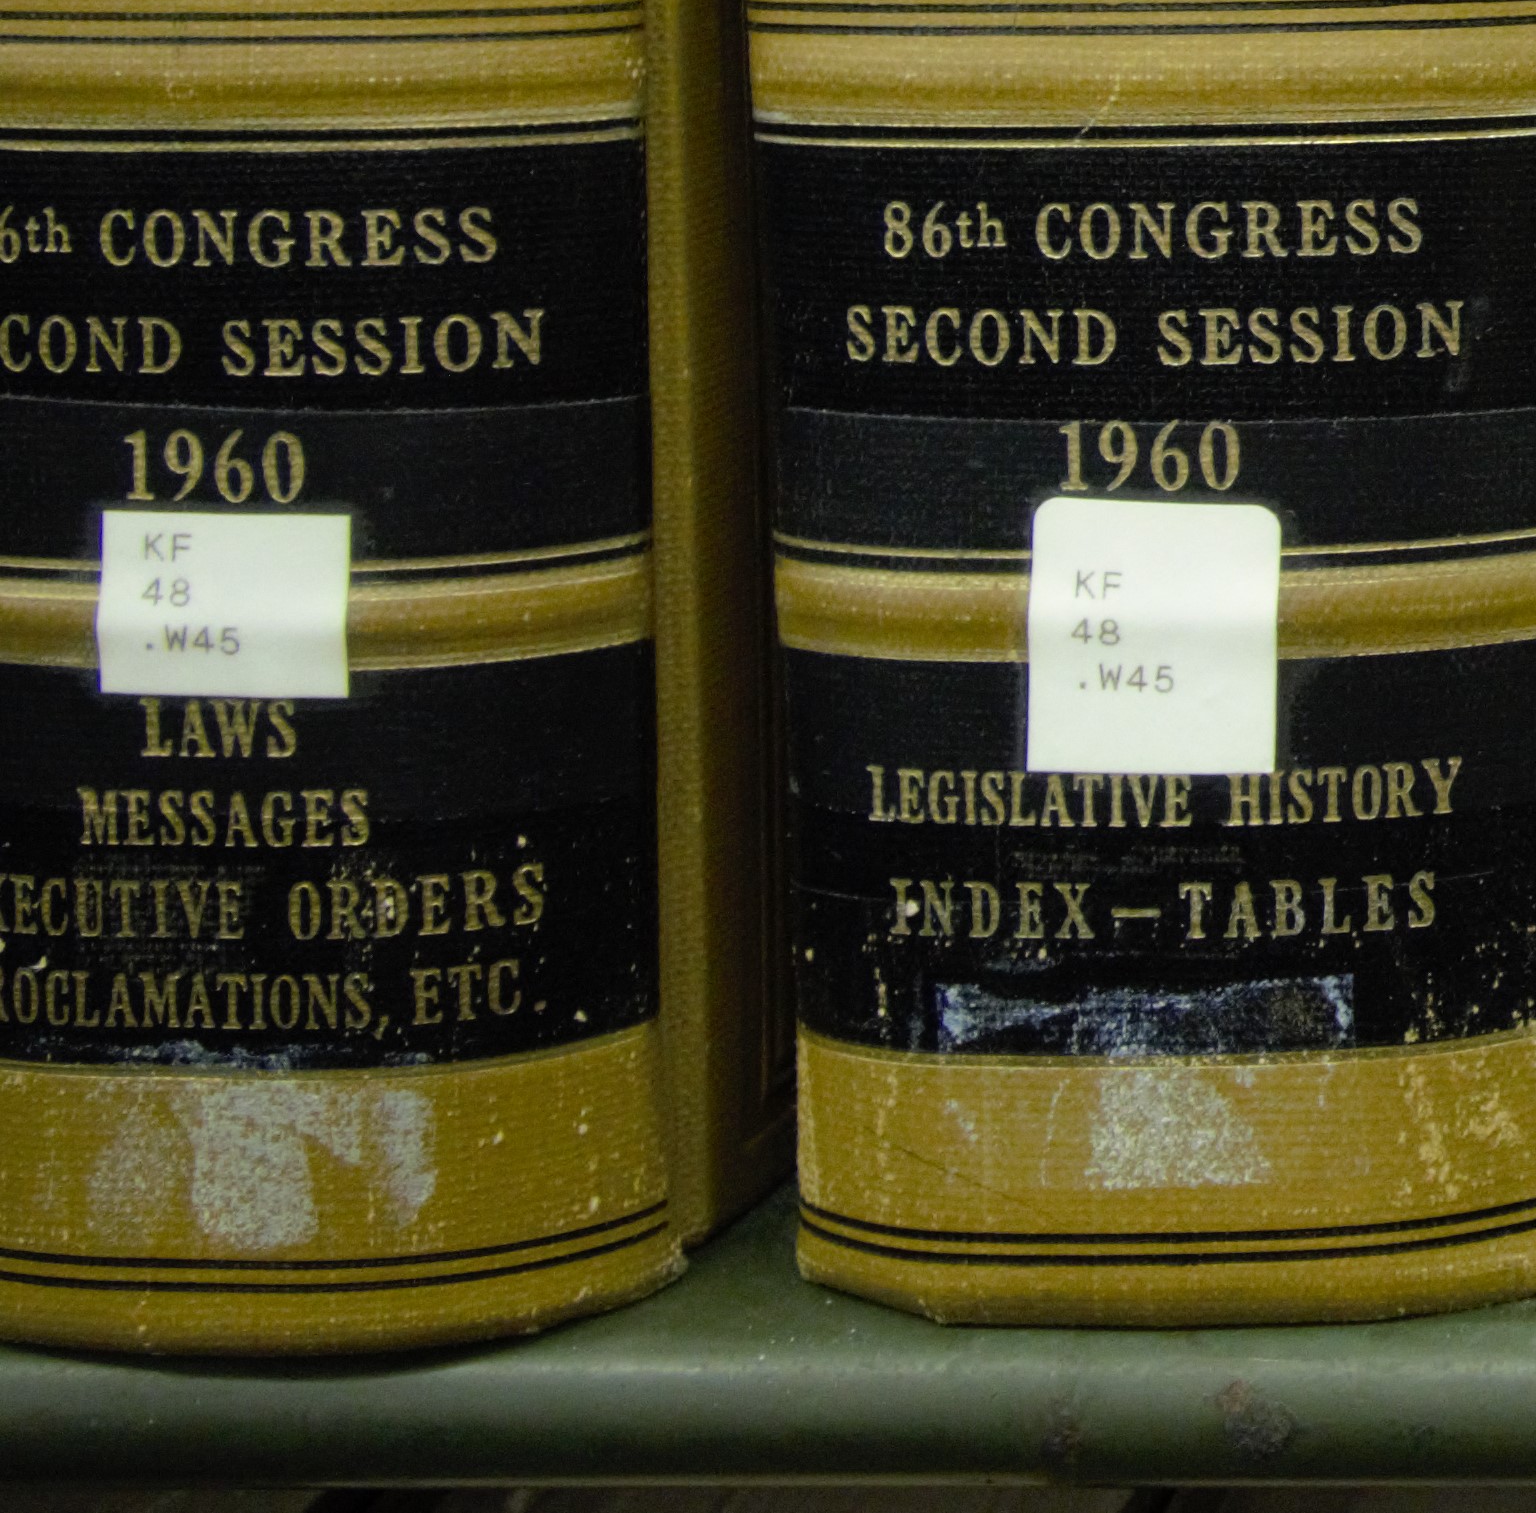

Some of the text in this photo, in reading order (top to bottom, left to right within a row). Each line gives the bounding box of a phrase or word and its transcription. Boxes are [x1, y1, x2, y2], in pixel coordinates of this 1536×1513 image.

[99, 206, 499, 268] CONGRESS
[882, 196, 1425, 261] 86th CONGRESS
[222, 309, 546, 377] SESSION
[845, 300, 1465, 367] SECOND SESSION
[124, 429, 307, 504] 1960
[1057, 419, 1241, 493] 1960
[144, 533, 192, 562] KF
[141, 577, 191, 608] 48
[1075, 570, 1123, 598] KF
[145, 626, 241, 656] .W45
[1070, 619, 1122, 647] 48
[1077, 663, 1176, 694] .W45
[139, 696, 296, 758] LAWS
[77, 788, 370, 849] MESSAGES
[867, 756, 1465, 829] LEGISLATIVE HISTORY
[288, 862, 546, 941] ORDERS
[0, 959, 548, 1039] OCLAMATIONS, ETC.
